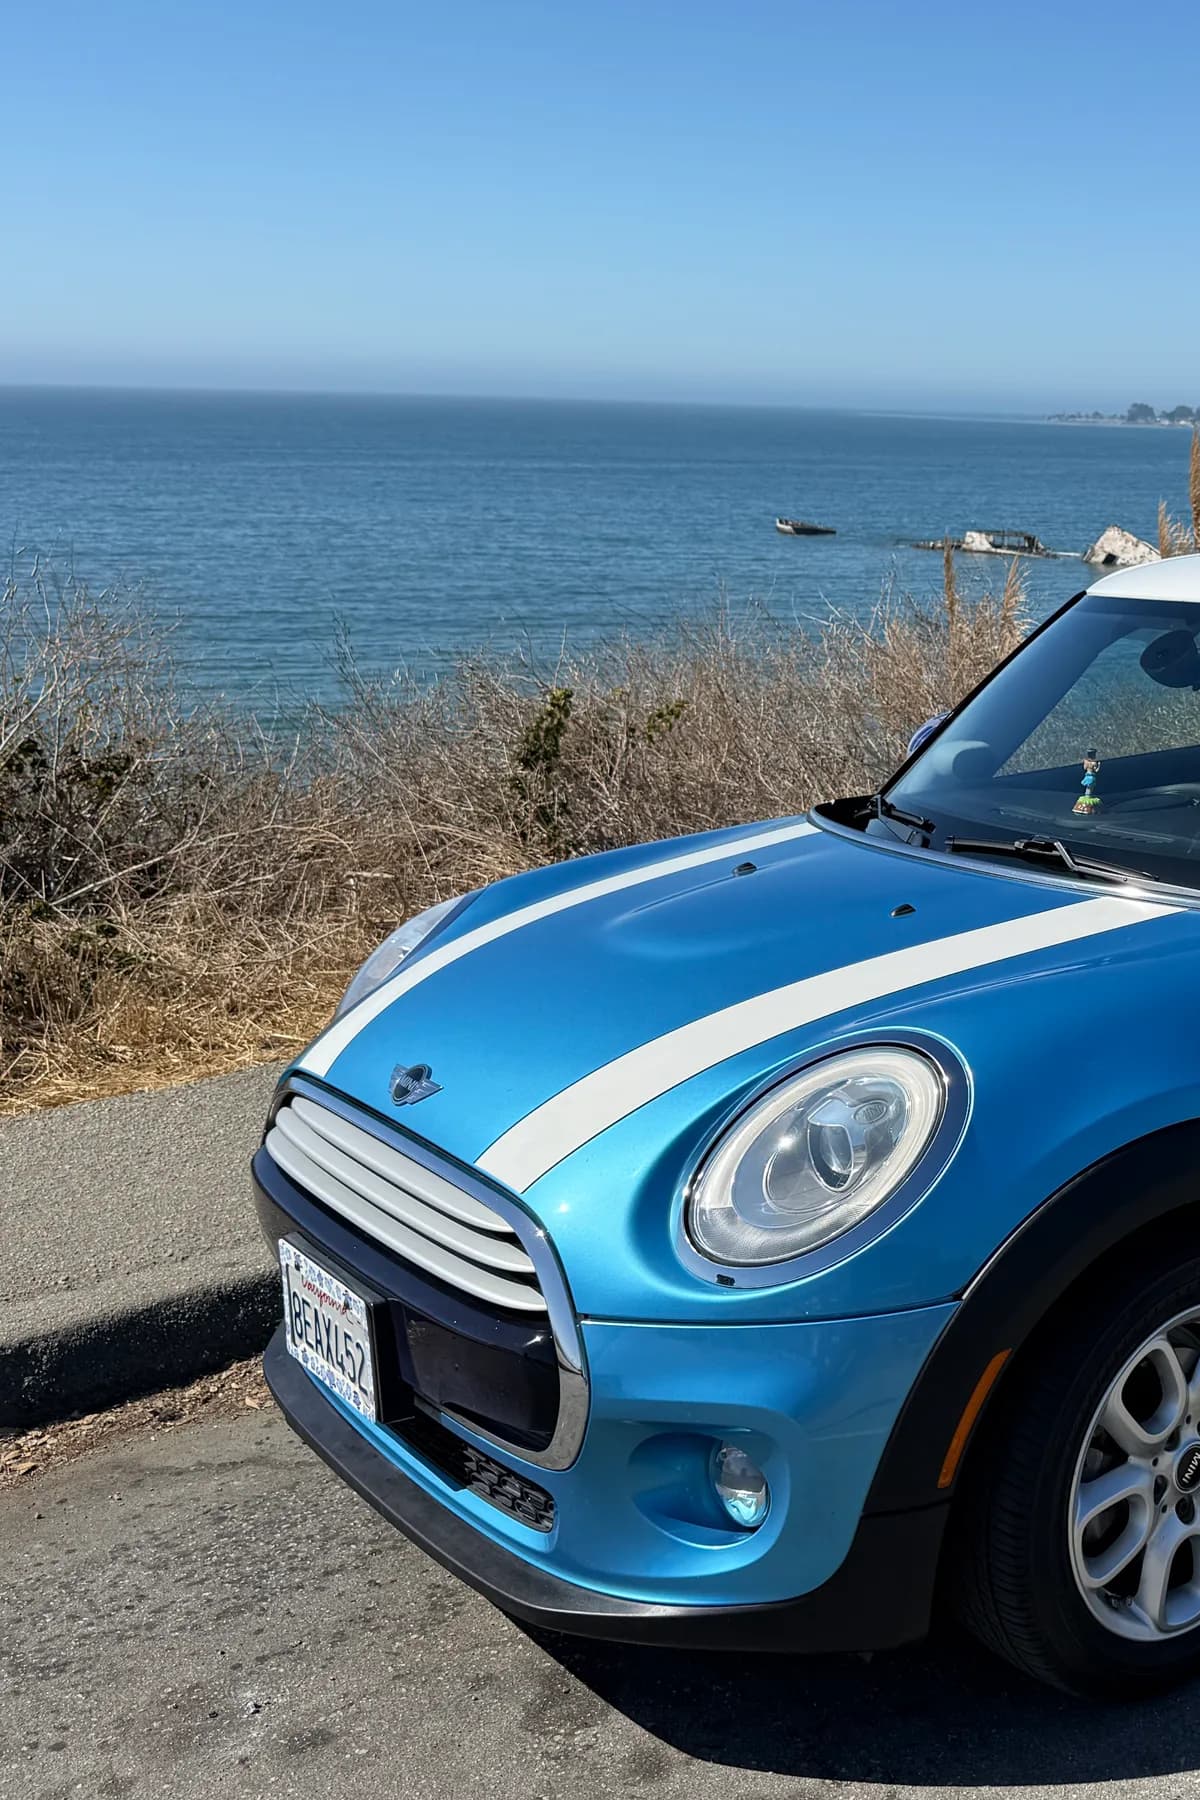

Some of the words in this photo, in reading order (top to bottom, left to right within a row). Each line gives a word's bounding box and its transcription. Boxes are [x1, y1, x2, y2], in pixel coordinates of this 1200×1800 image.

[399, 1074, 418, 1091] MINI
[857, 1104, 883, 1119] MINI
[292, 1291, 369, 1396] 8EAX452
[1182, 1452, 1200, 1484] MINI
